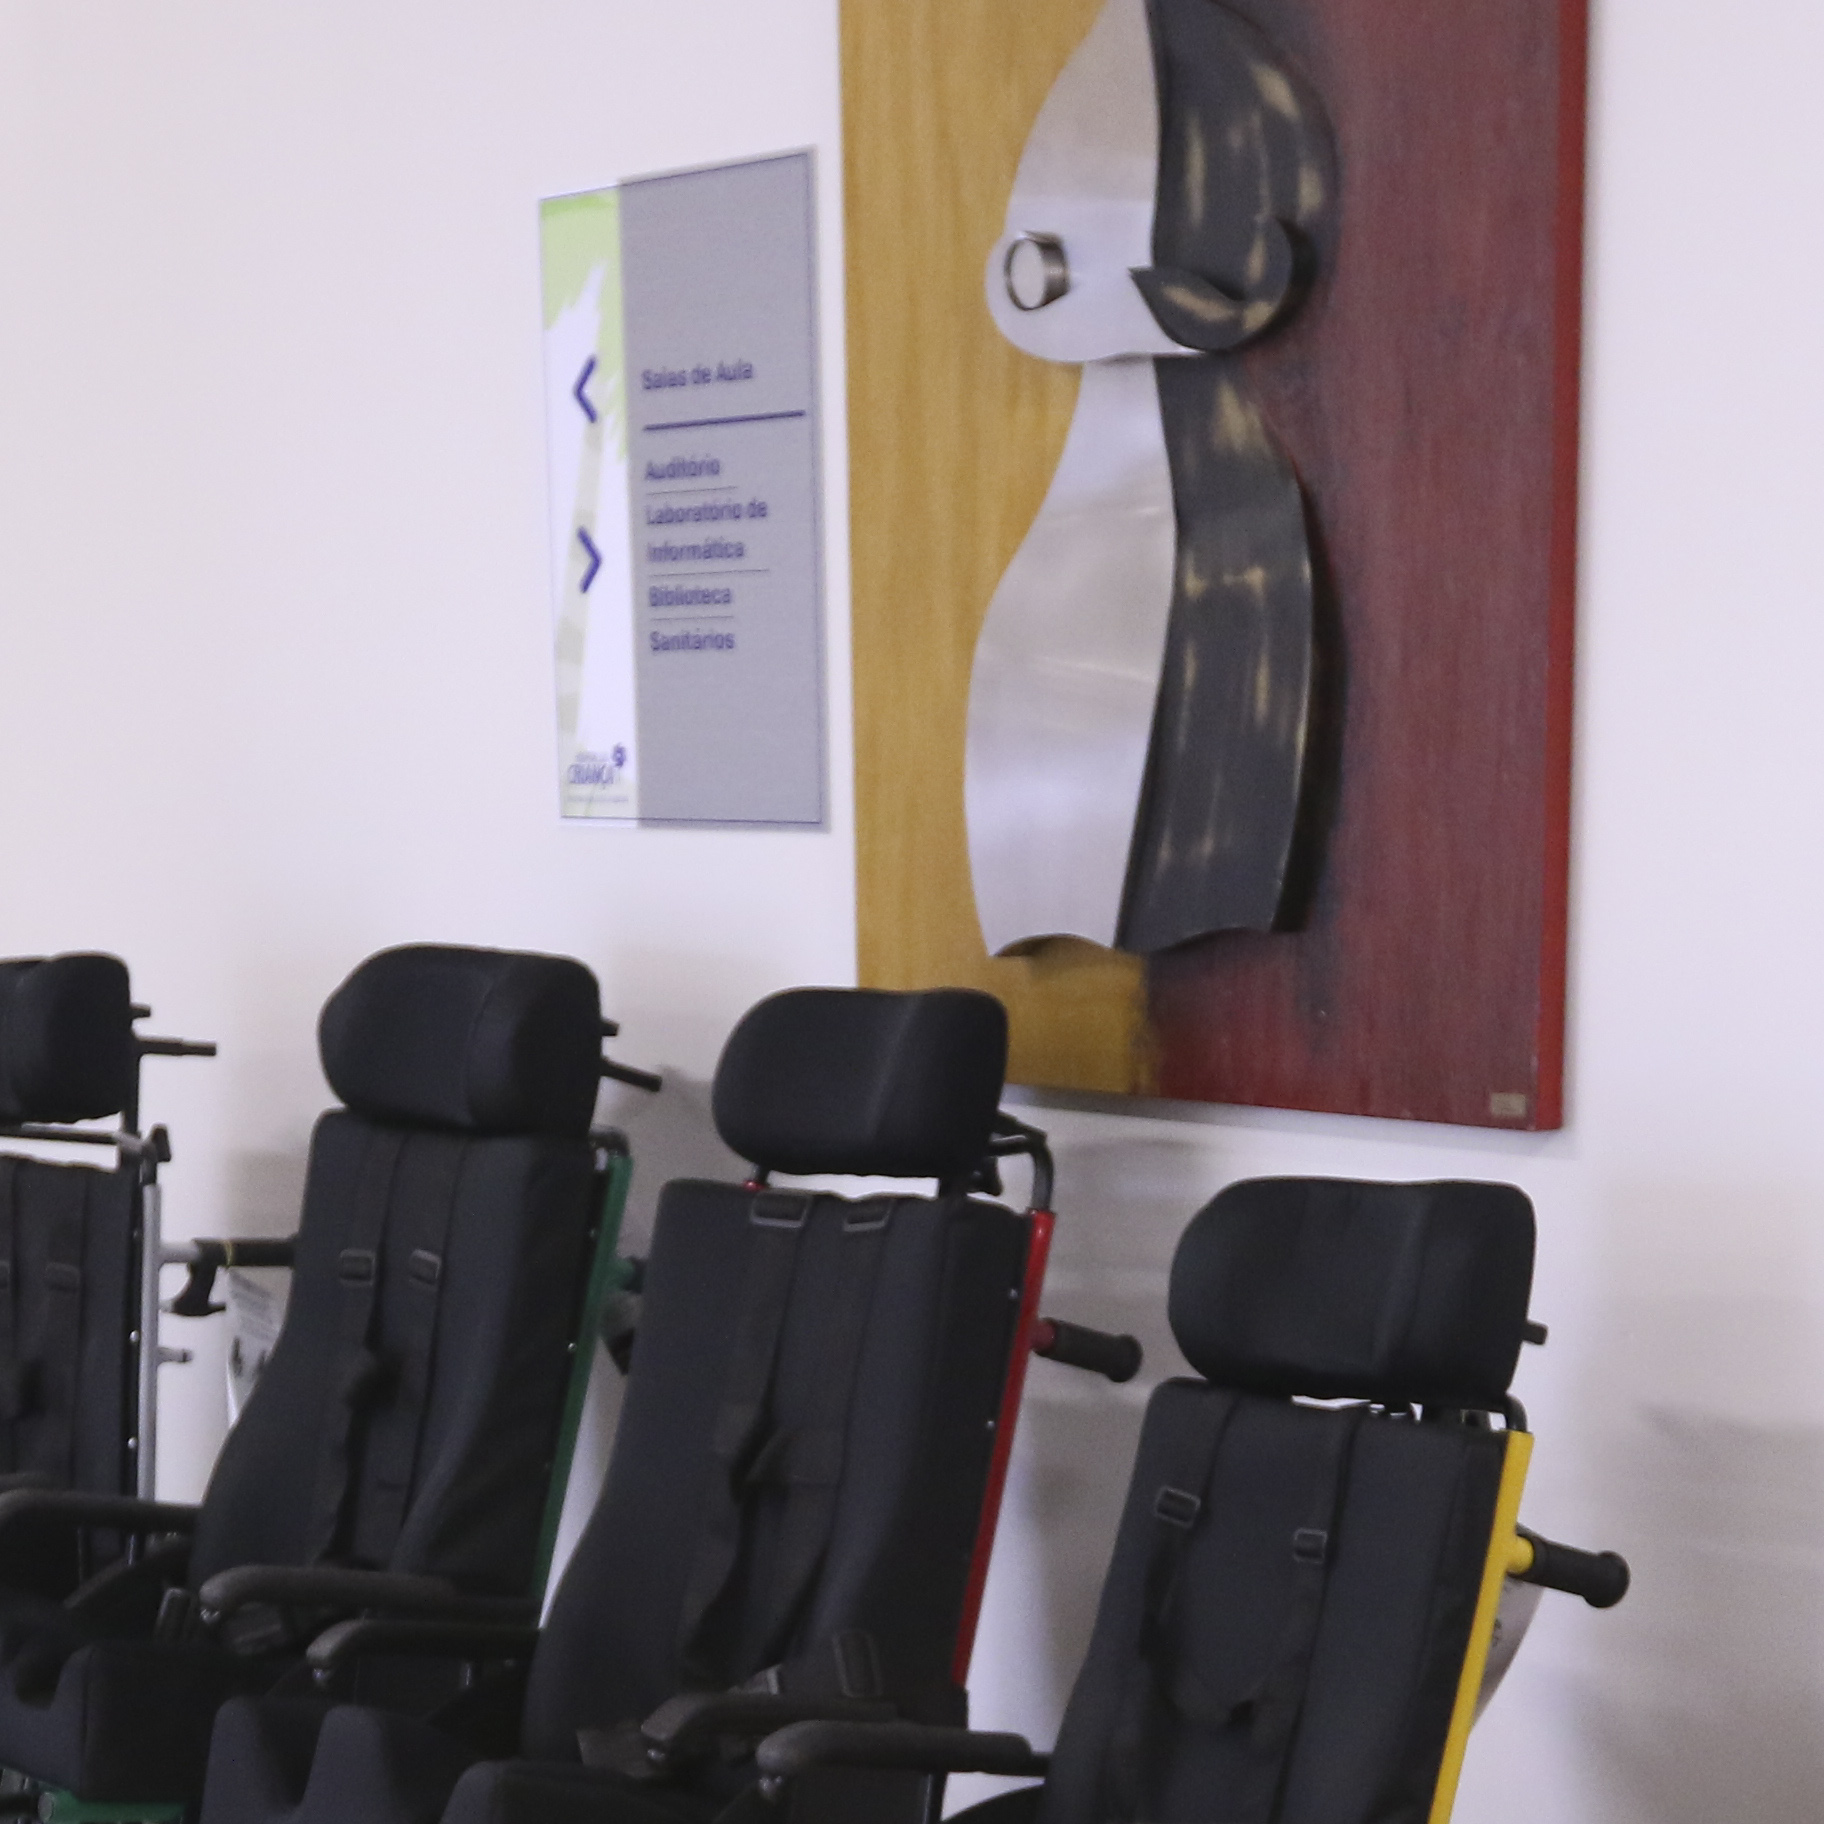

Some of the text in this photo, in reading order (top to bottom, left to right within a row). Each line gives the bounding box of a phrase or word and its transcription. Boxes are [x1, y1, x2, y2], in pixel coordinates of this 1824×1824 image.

[642, 360, 753, 389] Salas de Aula
[646, 454, 720, 479] Auditório
[646, 498, 767, 524] Laboratório de
[647, 537, 744, 561] Informática
[649, 586, 730, 606] Biblioteca
[650, 630, 735, 651] Sanitários
